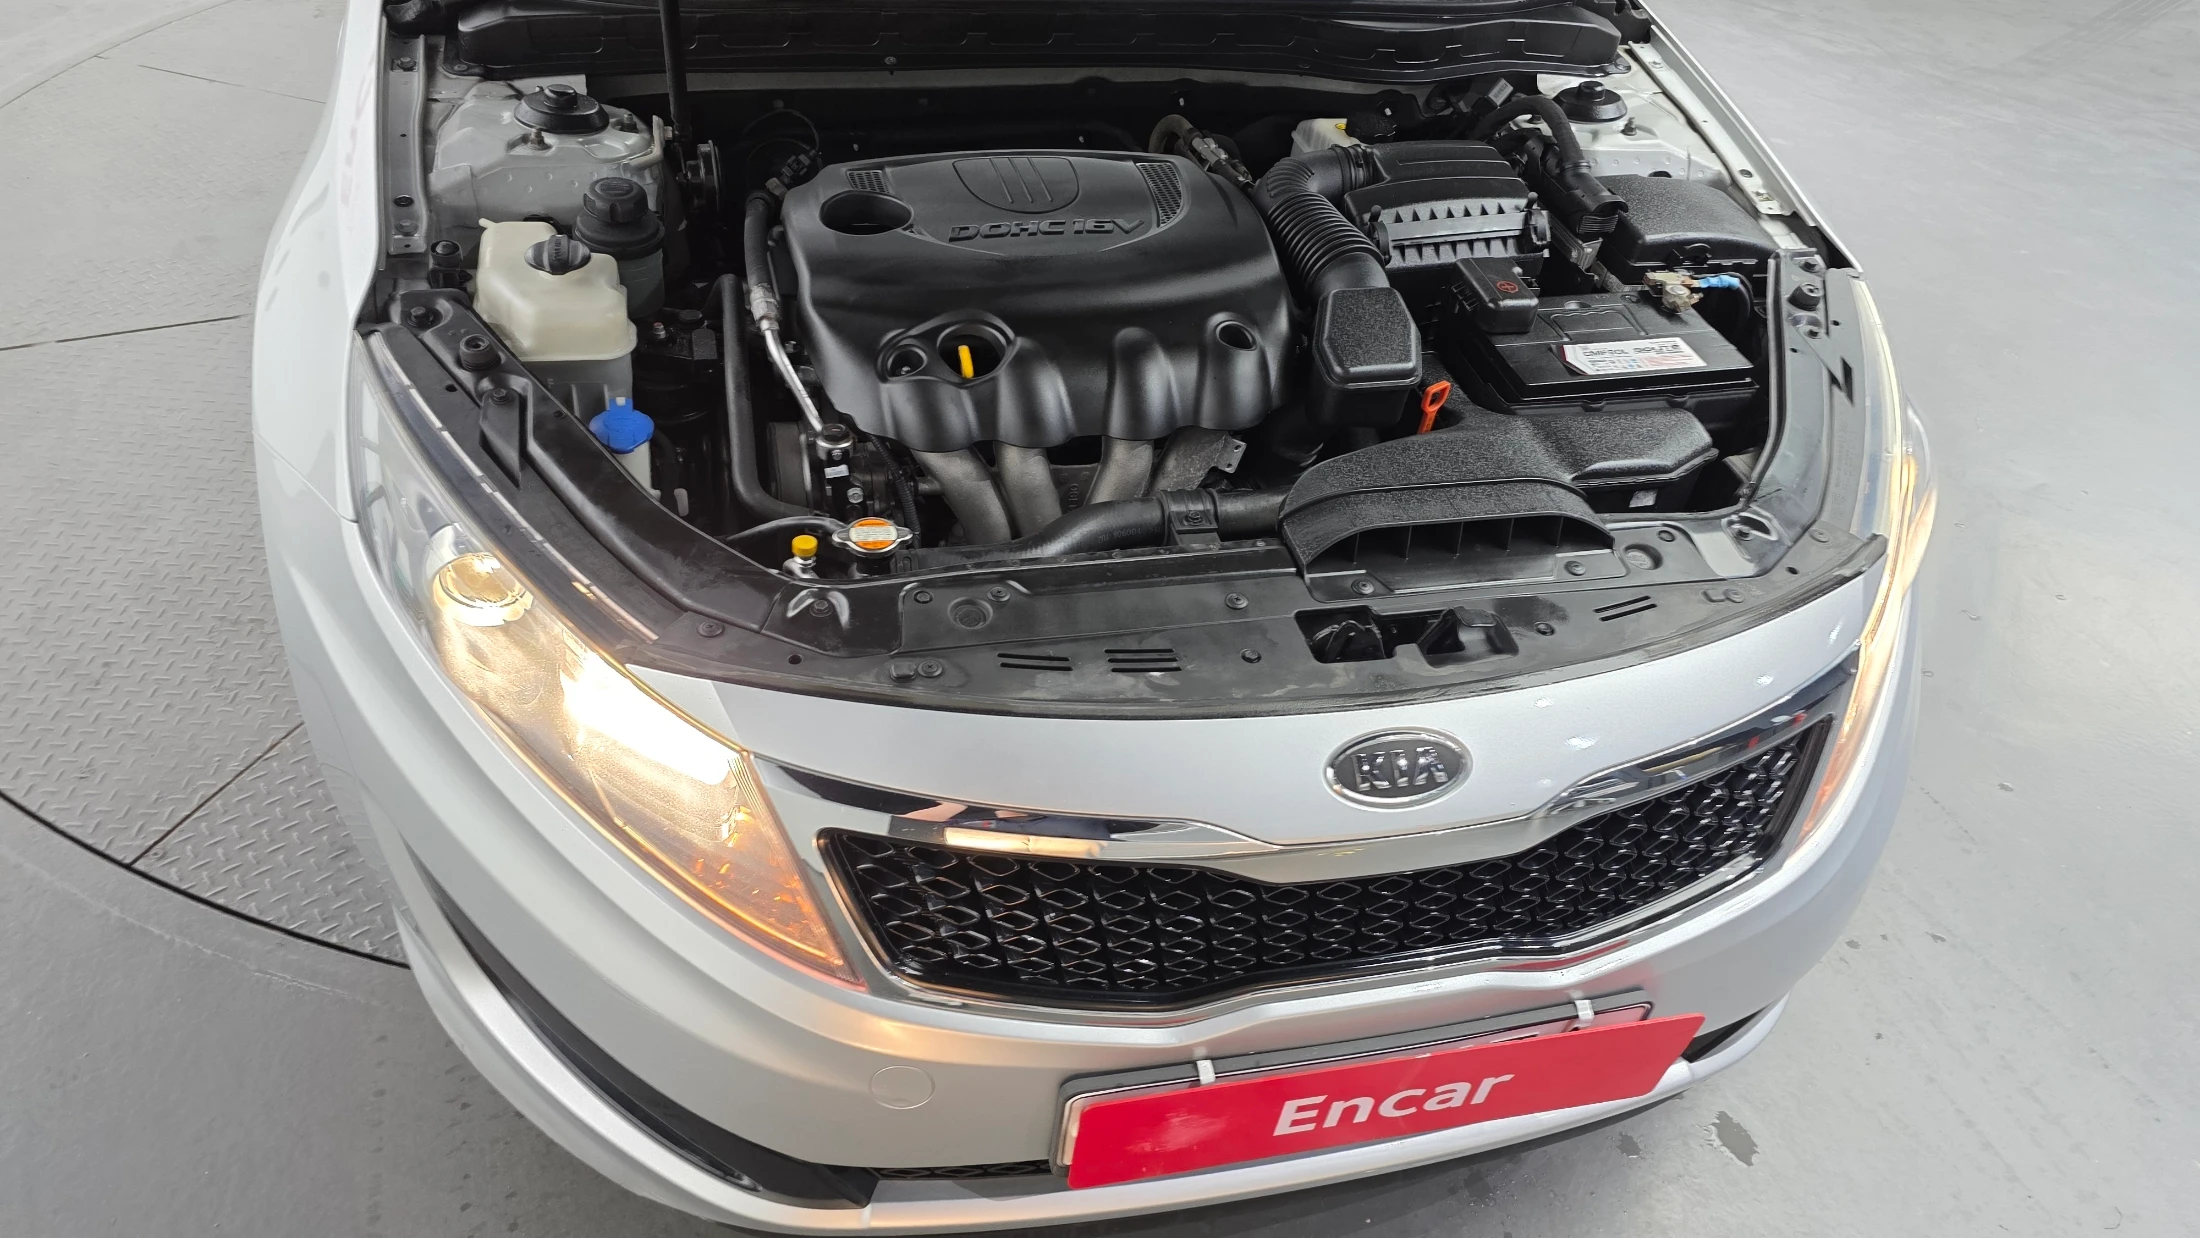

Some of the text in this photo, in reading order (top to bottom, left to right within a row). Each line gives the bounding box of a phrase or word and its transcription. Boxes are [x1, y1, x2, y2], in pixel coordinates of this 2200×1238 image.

[949, 218, 1145, 242] DOHC 16V
[1352, 746, 1449, 791] KIA
[1273, 1074, 1515, 1136] Encar
